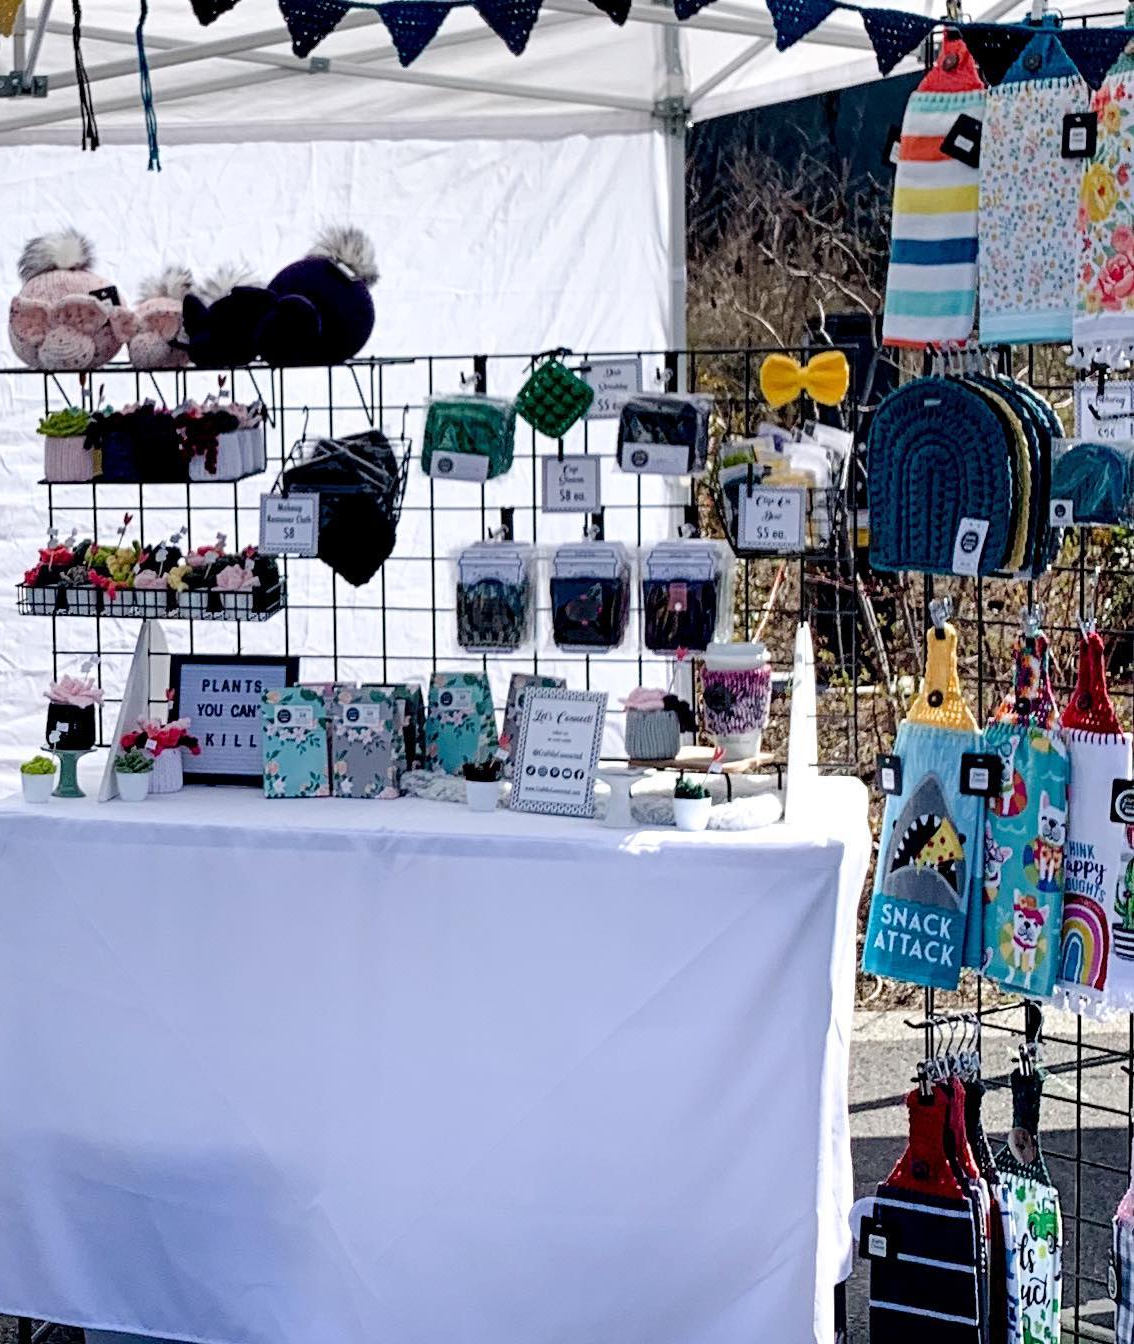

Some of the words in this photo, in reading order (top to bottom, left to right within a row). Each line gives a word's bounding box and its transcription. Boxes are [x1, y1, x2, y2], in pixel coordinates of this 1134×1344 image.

[201, 678, 262, 693] PLANTS
[197, 703, 223, 717] YOU
[230, 703, 262, 718] CAN'
[205, 733, 258, 747] KILL
[1066, 840, 1095, 859] HINK
[1065, 860, 1107, 885] appy
[1065, 877, 1107, 903] OUGHTS
[881, 903, 953, 940] SNACK
[873, 930, 955, 968] ATTACK
